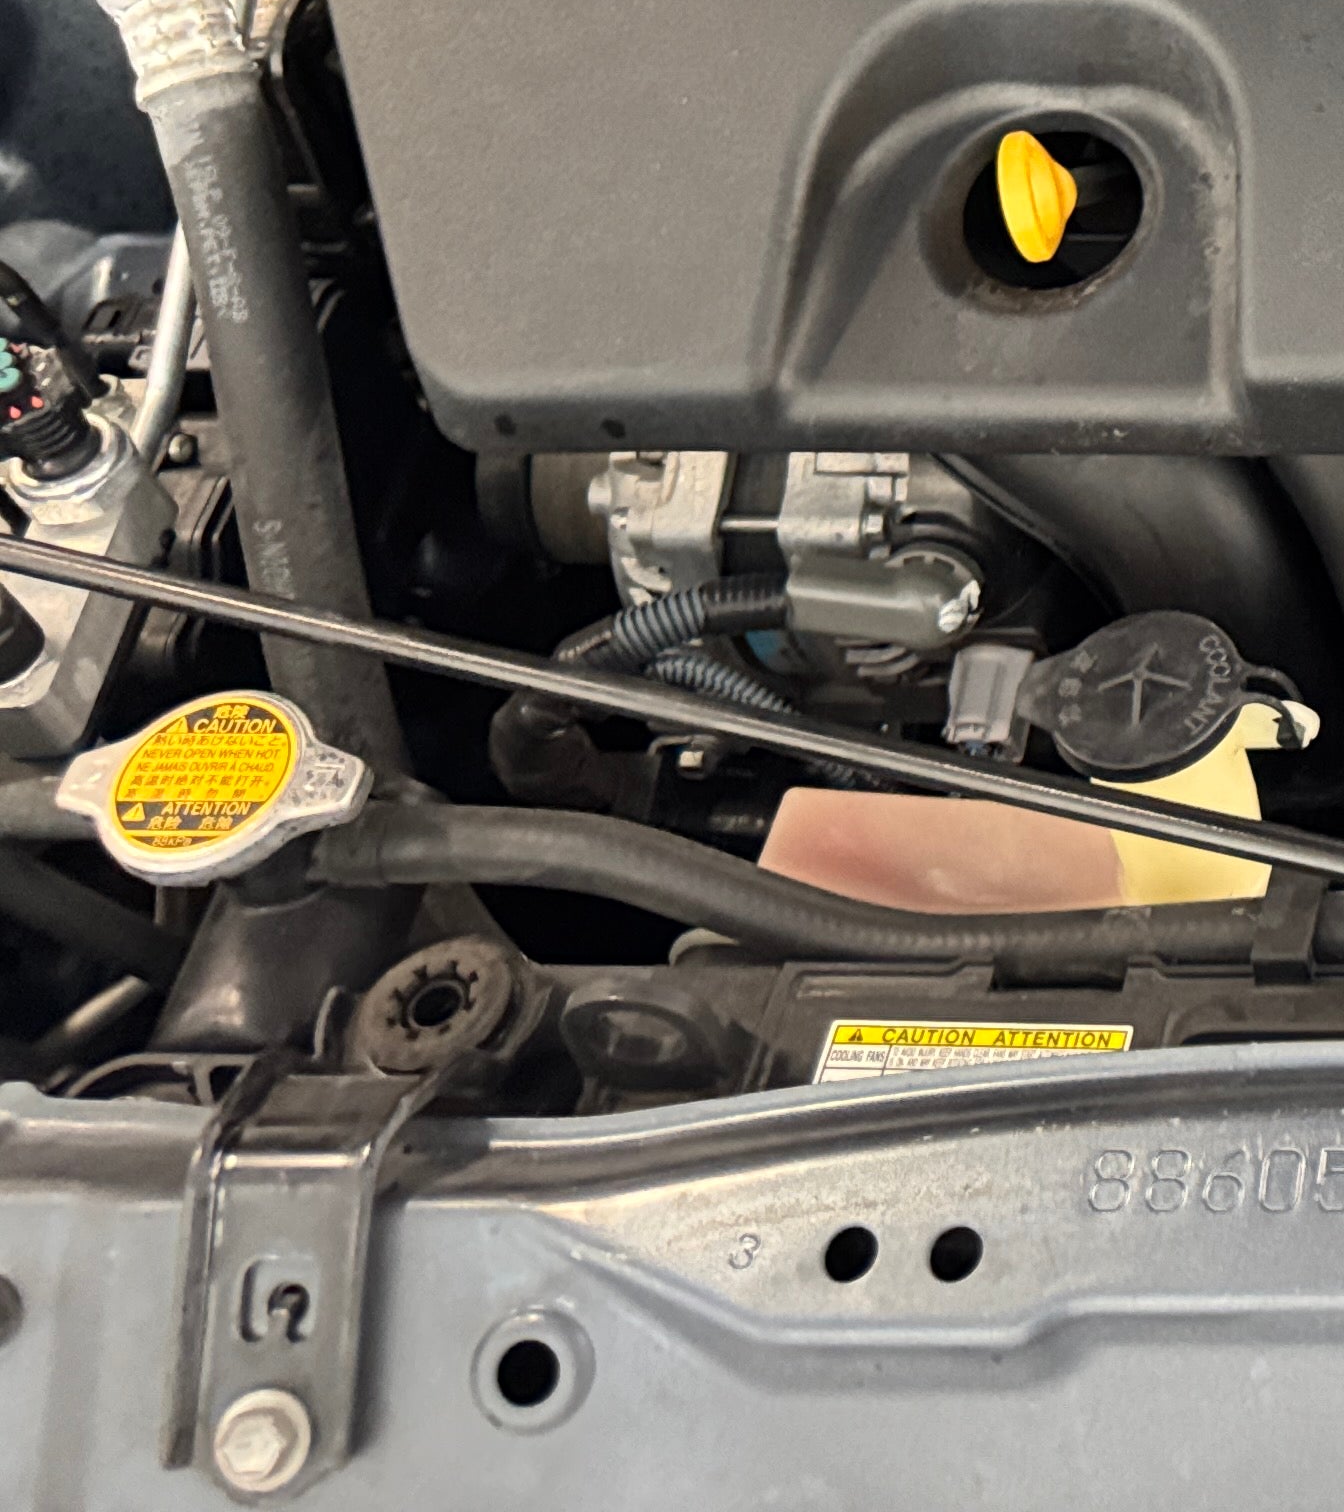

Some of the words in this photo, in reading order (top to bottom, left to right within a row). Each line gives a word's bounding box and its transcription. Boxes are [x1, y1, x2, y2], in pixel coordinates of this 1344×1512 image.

[1184, 634, 1231, 736] COOLANT
[193, 718, 277, 734] CAUTION
[143, 749, 181, 759] NEVER
[184, 749, 216, 758] OPEN
[219, 749, 253, 758] WHEN
[136, 762, 150, 772] NE
[152, 762, 187, 772] JAMAIS
[189, 762, 228, 772] OUVRIR
[162, 801, 252, 816] ATTENTION
[881, 1027, 976, 1044] CAUTION
[992, 1030, 1112, 1048] ATTENTION
[831, 1050, 864, 1062] COOLING
[866, 1050, 886, 1062] FANS
